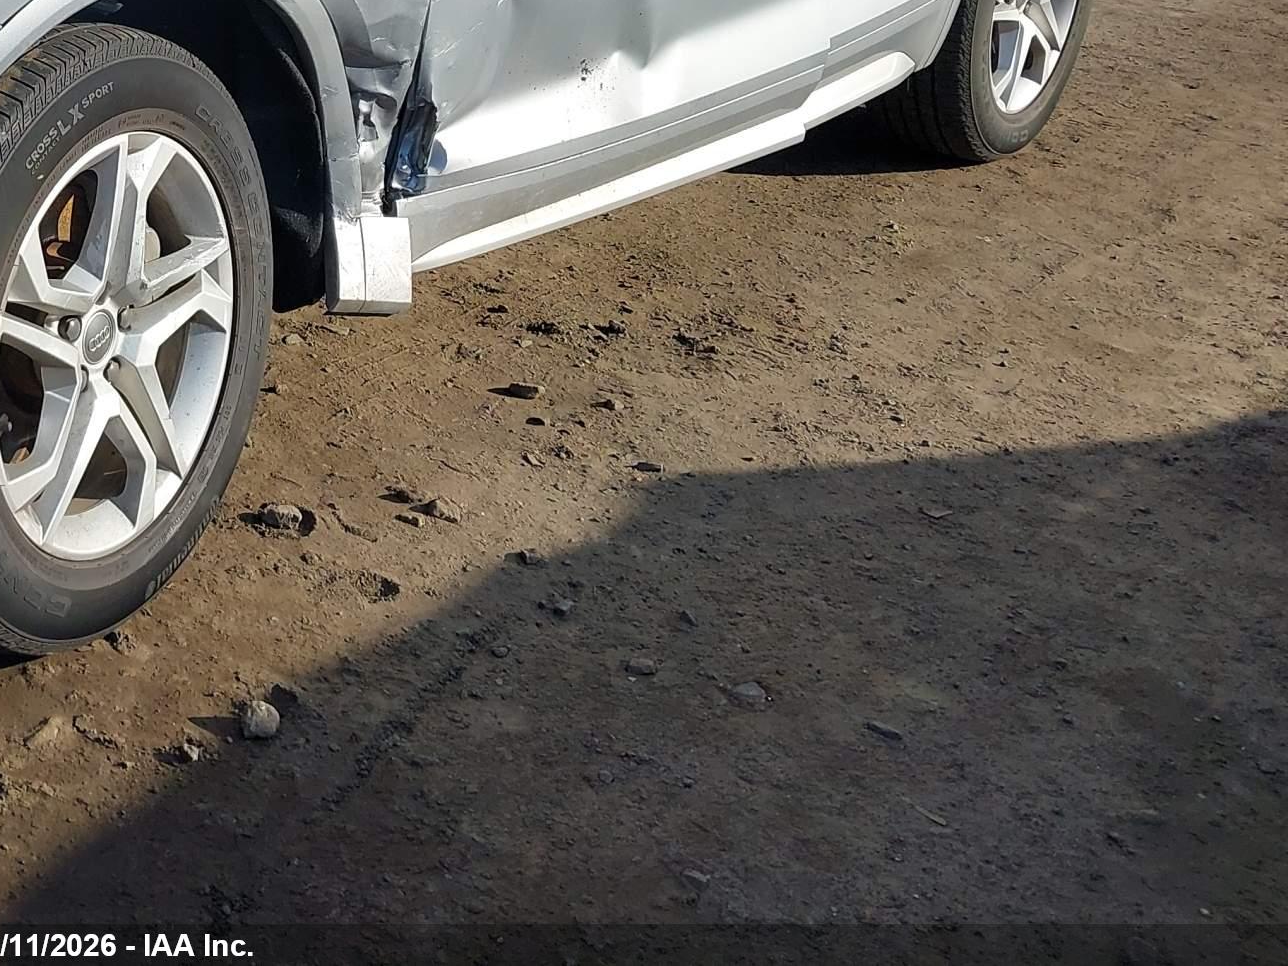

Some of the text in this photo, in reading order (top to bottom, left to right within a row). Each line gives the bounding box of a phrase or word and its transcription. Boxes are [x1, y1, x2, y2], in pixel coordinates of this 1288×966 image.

[25, 126, 58, 170] CROSS
[57, 103, 85, 136] LX
[81, 81, 114, 109] SPORT
[195, 103, 252, 186] CROSS
